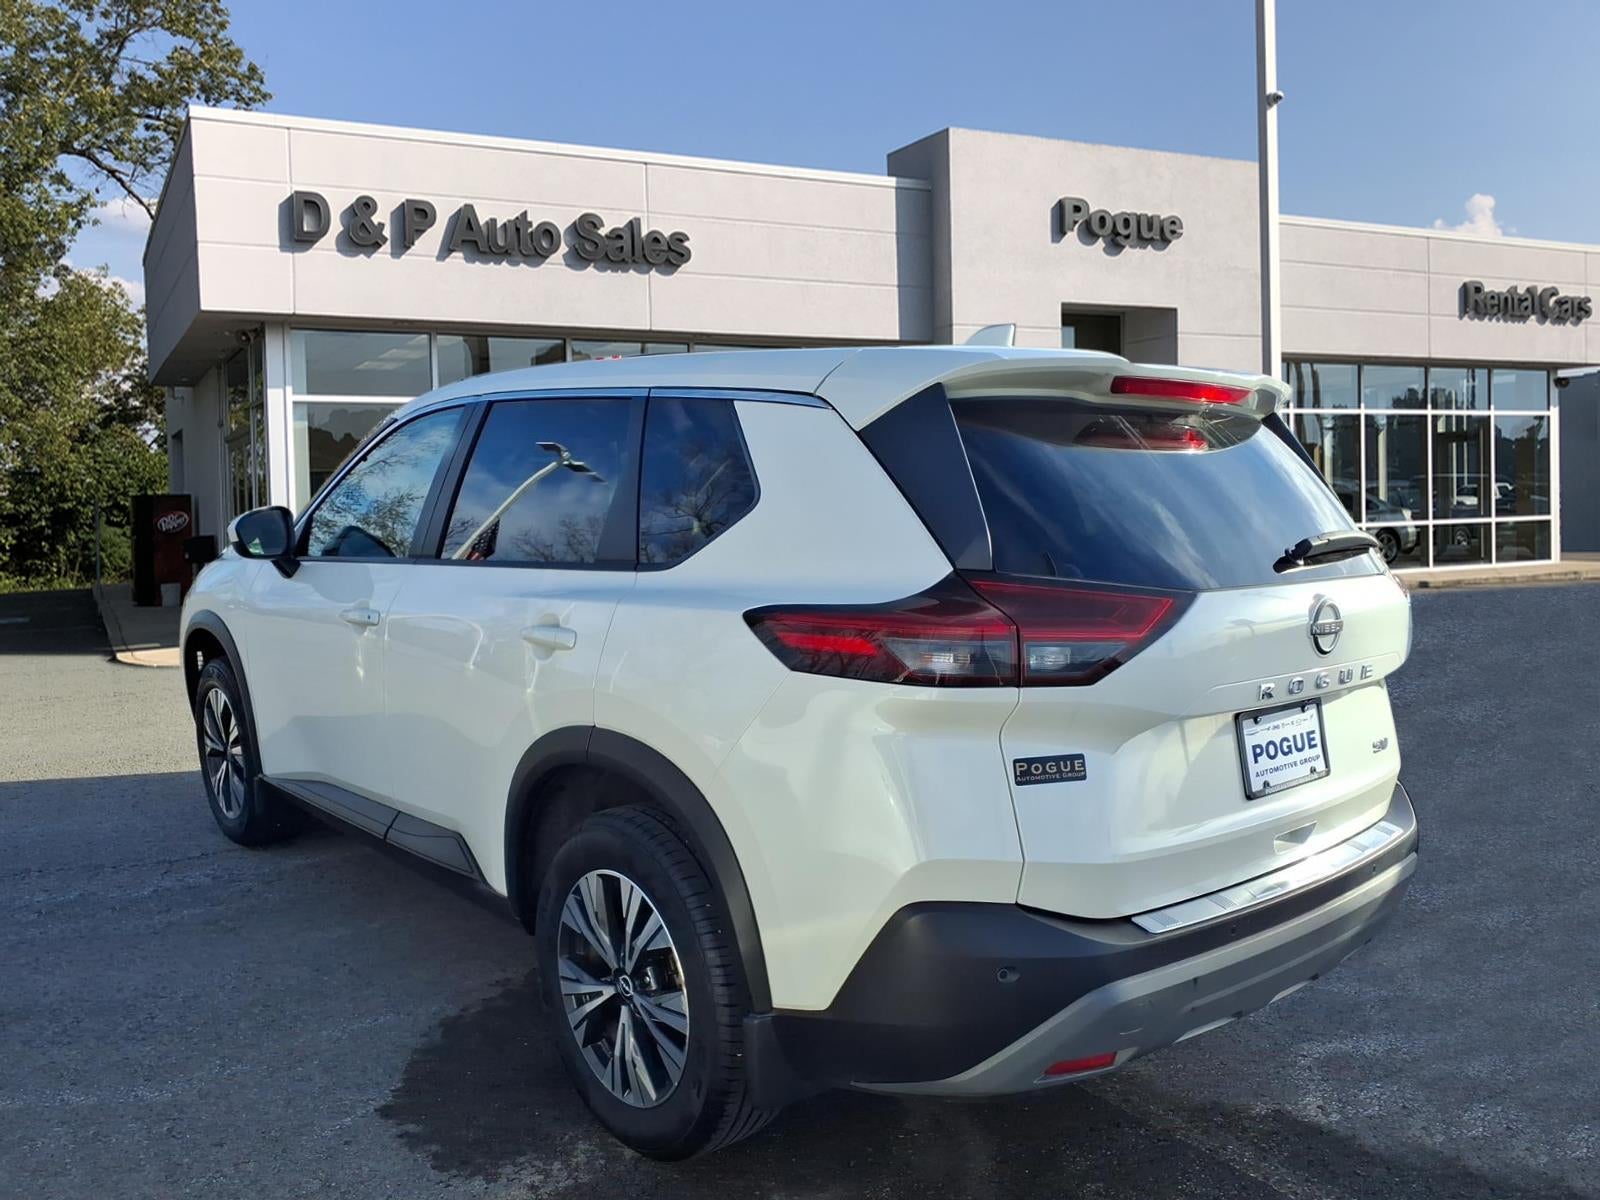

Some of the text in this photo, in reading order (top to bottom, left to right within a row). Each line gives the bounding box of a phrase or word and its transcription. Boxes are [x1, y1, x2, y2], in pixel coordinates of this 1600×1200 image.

[294, 191, 692, 266] D & P Auto Sales
[1060, 196, 1183, 247] Pogue
[1464, 280, 1592, 321] Rental Cars
[1259, 665, 1373, 700] ROGUE
[1251, 729, 1318, 764] POGUE
[1015, 759, 1084, 776] POGUE
[1255, 754, 1321, 778] AUTOMOTIVE GROUP
